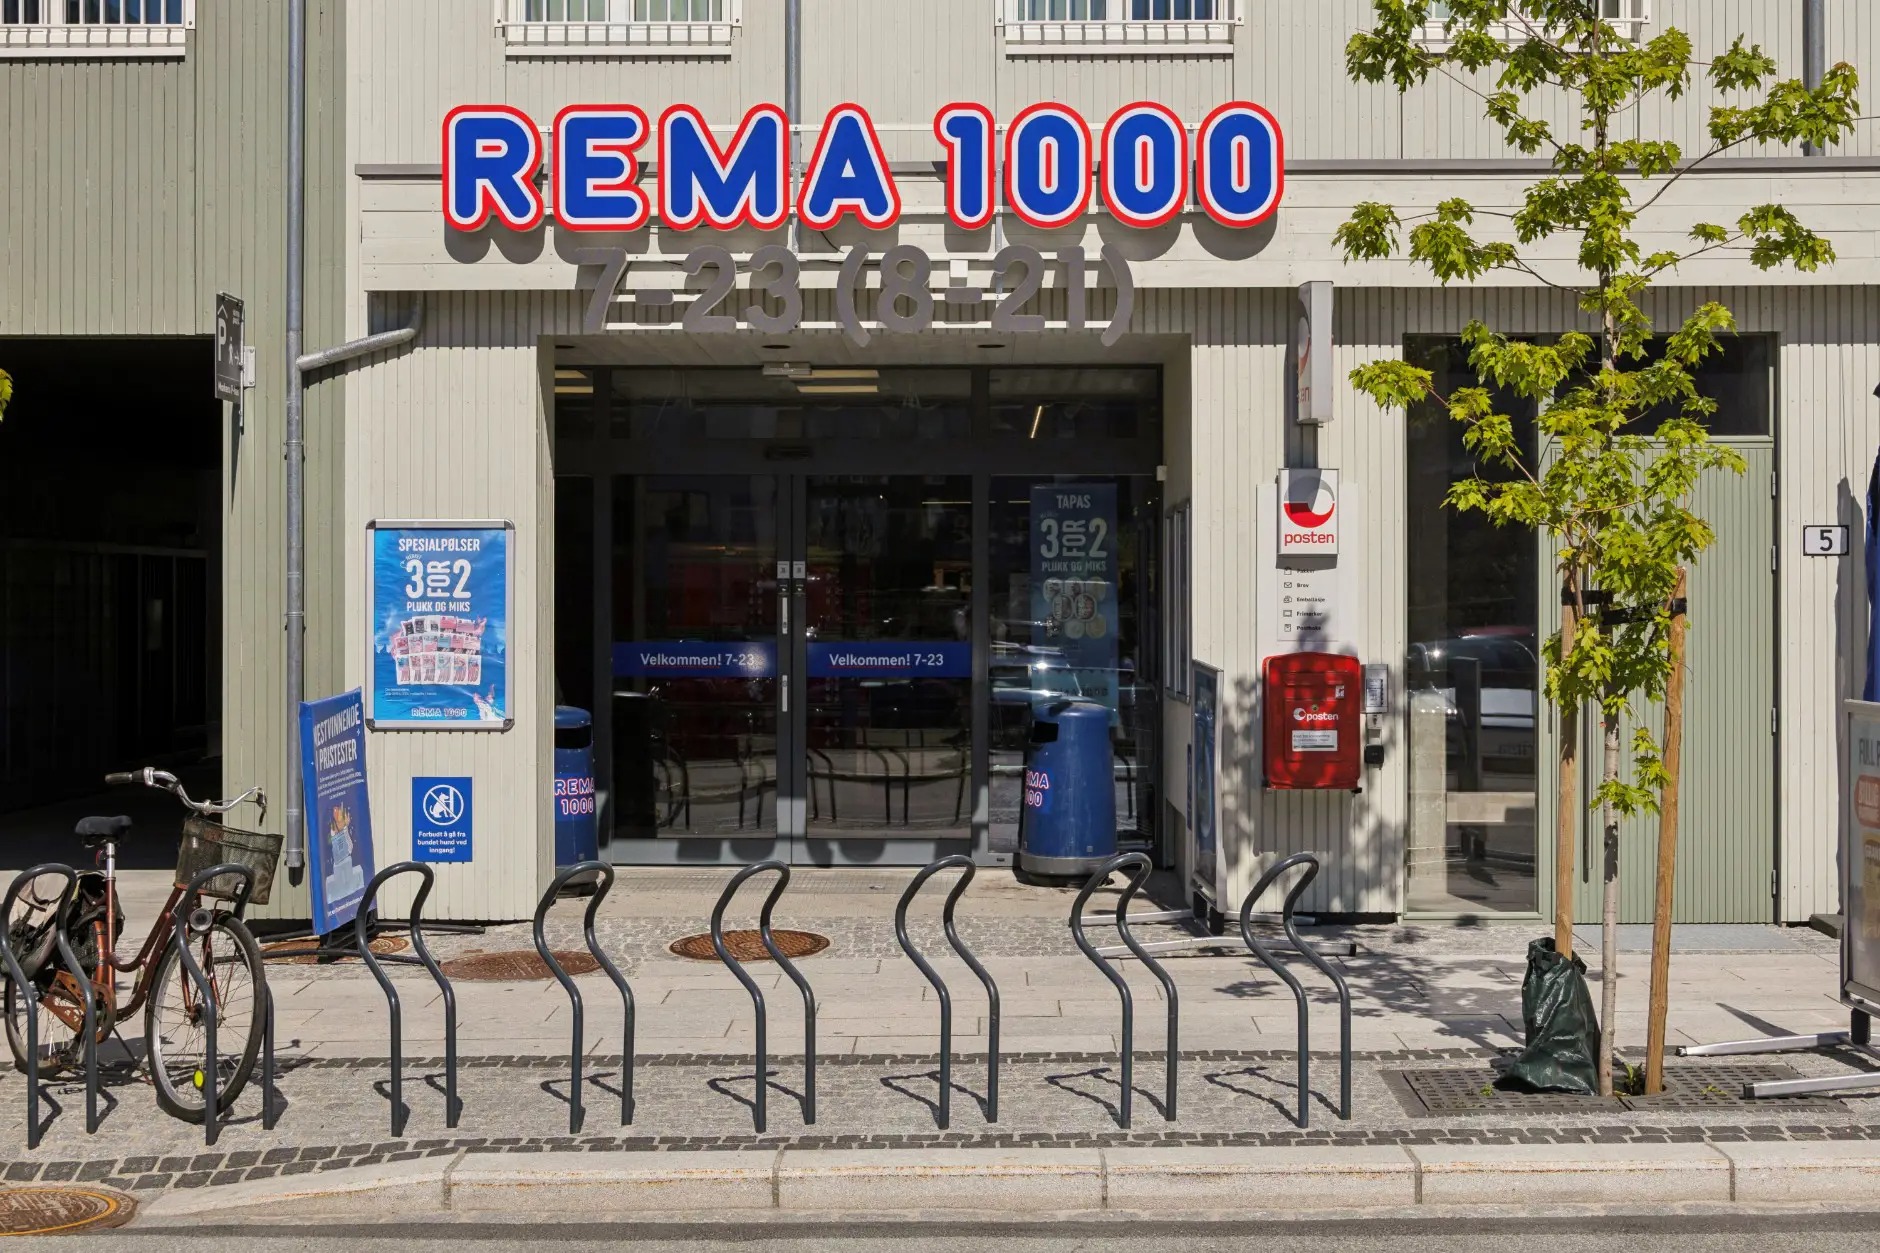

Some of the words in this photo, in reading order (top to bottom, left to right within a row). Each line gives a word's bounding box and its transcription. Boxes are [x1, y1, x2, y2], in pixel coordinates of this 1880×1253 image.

[442, 103, 901, 232] REMA
[934, 101, 1284, 229] 1000
[575, 245, 801, 333] 7-23
[836, 241, 1134, 347] (8-21)
[217, 317, 227, 361] P
[1056, 494, 1091, 509] TAPAS
[398, 538, 480, 552] SPESIALPØLSER
[1041, 518, 1059, 558] 3
[1062, 520, 1086, 556] FOR
[1089, 518, 1107, 557] 2
[1284, 531, 1334, 546] posten
[1820, 529, 1833, 551] 5
[1042, 561, 1068, 571] PLUKK
[1070, 561, 1082, 571] OG
[1085, 561, 1106, 571] MIKS
[406, 559, 424, 599] 3
[427, 561, 450, 597] FOR
[453, 559, 472, 599] 2
[407, 602, 433, 612] PLUKK
[435, 602, 447, 612] OG
[449, 602, 470, 612] MIKS
[640, 653, 722, 666] Velkommen!
[725, 654, 755, 666] 7-23
[829, 653, 910, 666] Velkommen!
[913, 654, 944, 666] 7-23
[411, 707, 442, 717] REMA
[1306, 711, 1339, 721] posten
[319, 739, 357, 771] PRISTESTER
[560, 797, 594, 815] 1000
